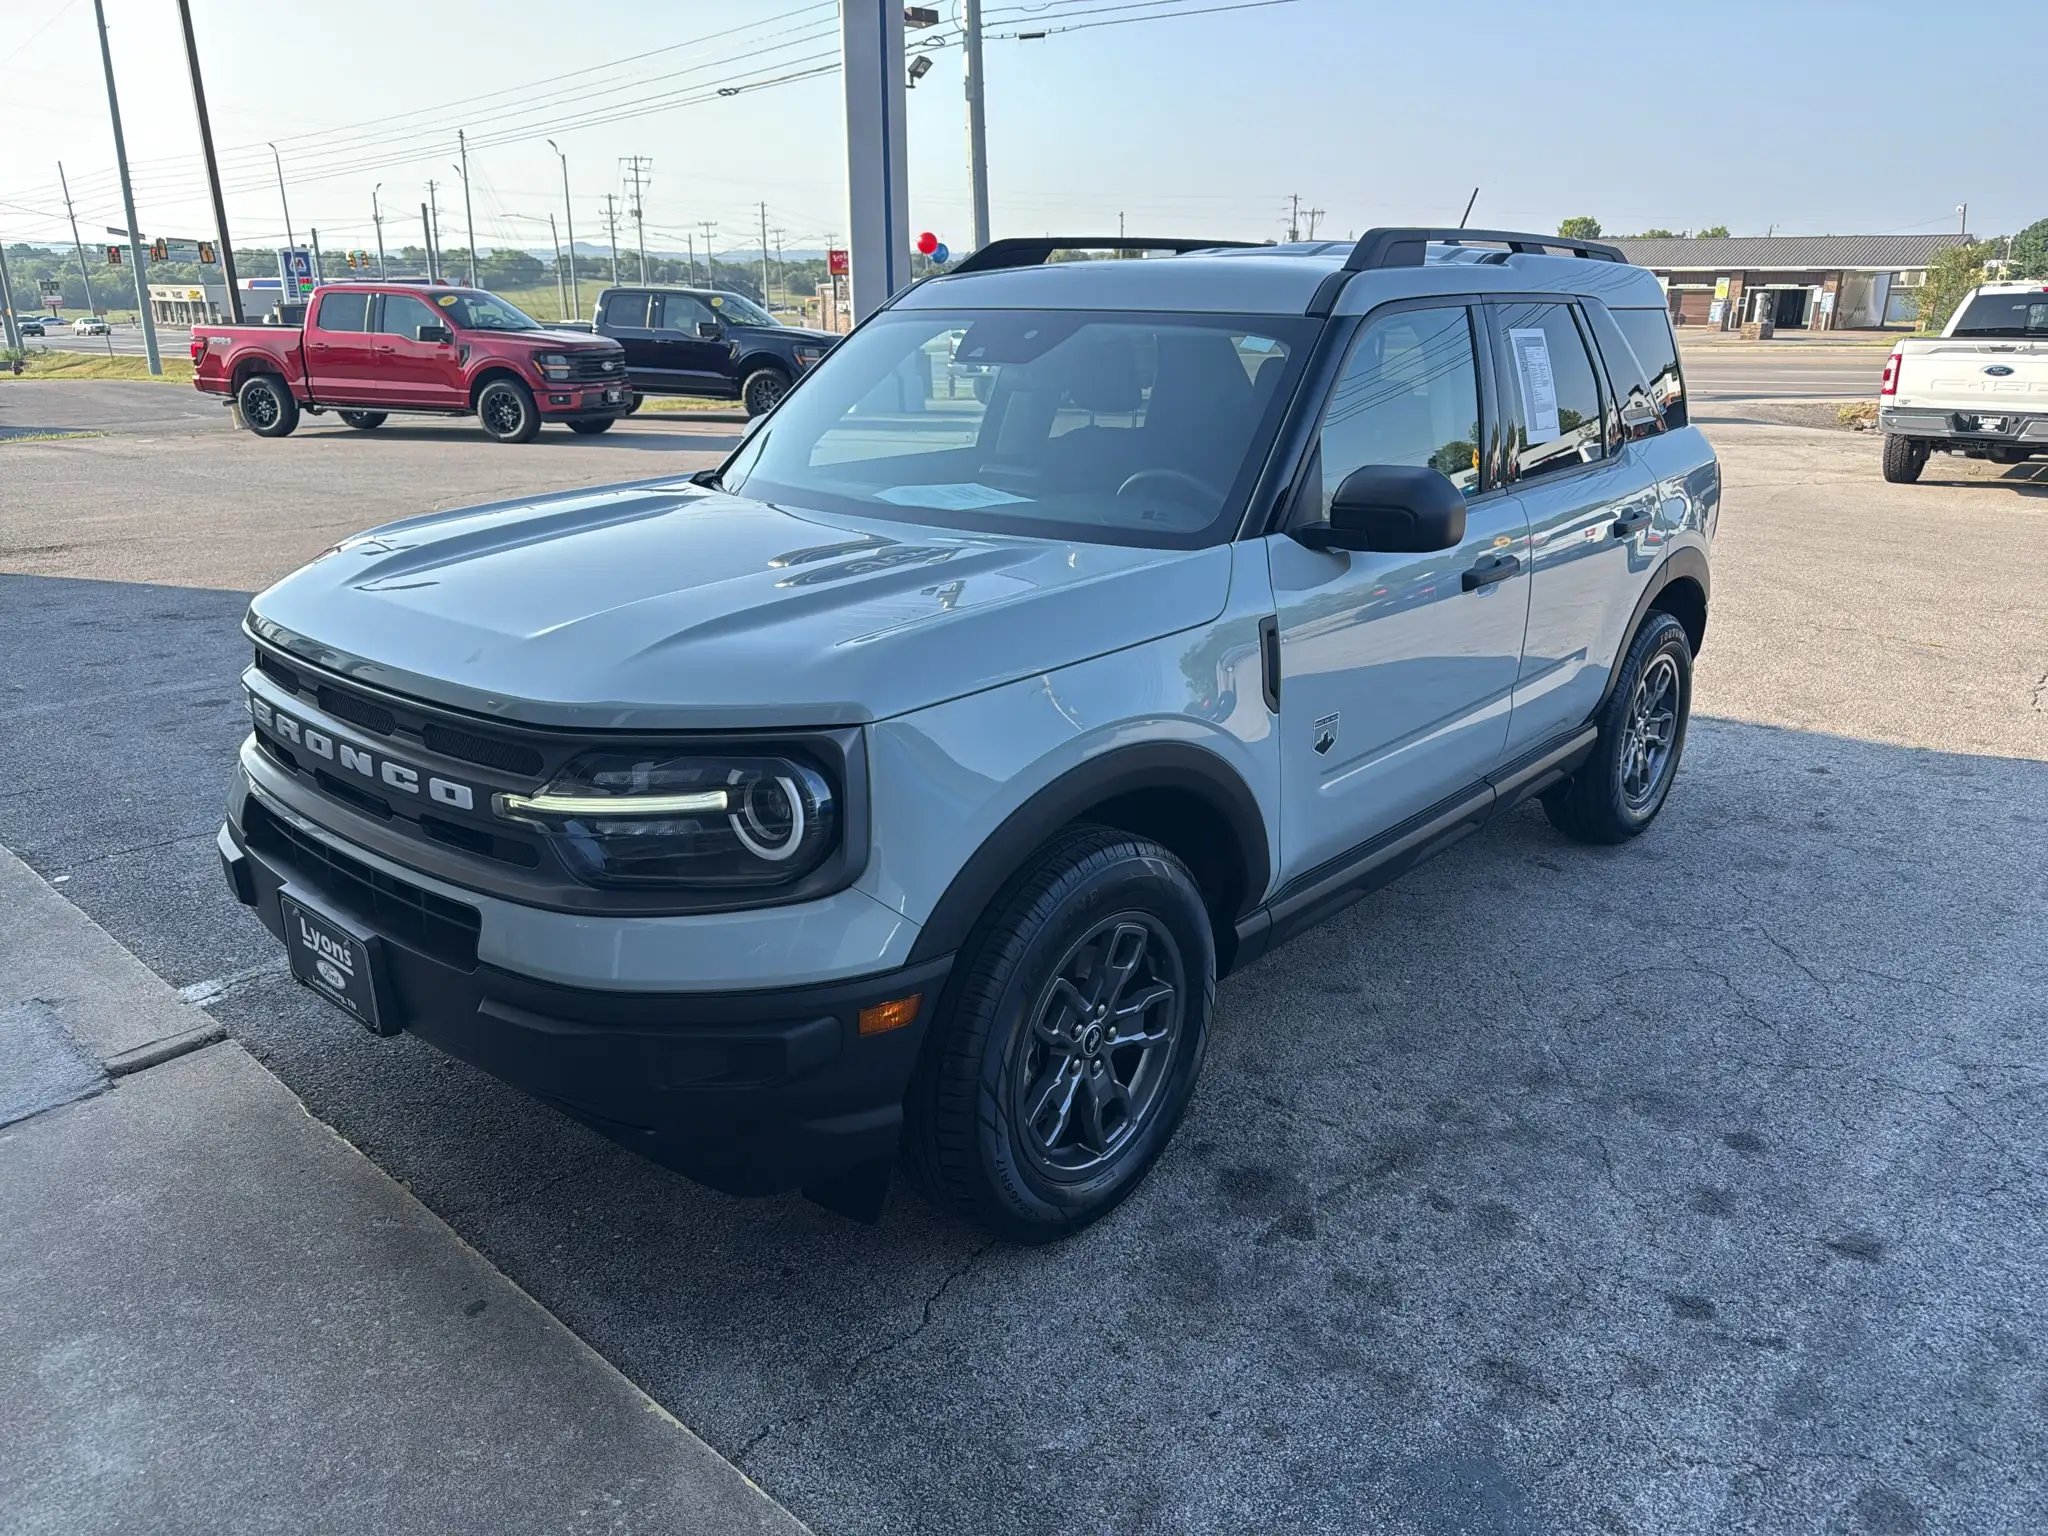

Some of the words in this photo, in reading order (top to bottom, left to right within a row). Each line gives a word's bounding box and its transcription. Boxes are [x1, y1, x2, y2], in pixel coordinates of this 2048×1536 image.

[1987, 366, 2011, 376] Ford
[1660, 628, 1686, 645] FORTUNE
[253, 697, 474, 811] BRONCO
[300, 916, 353, 967] Lyons
